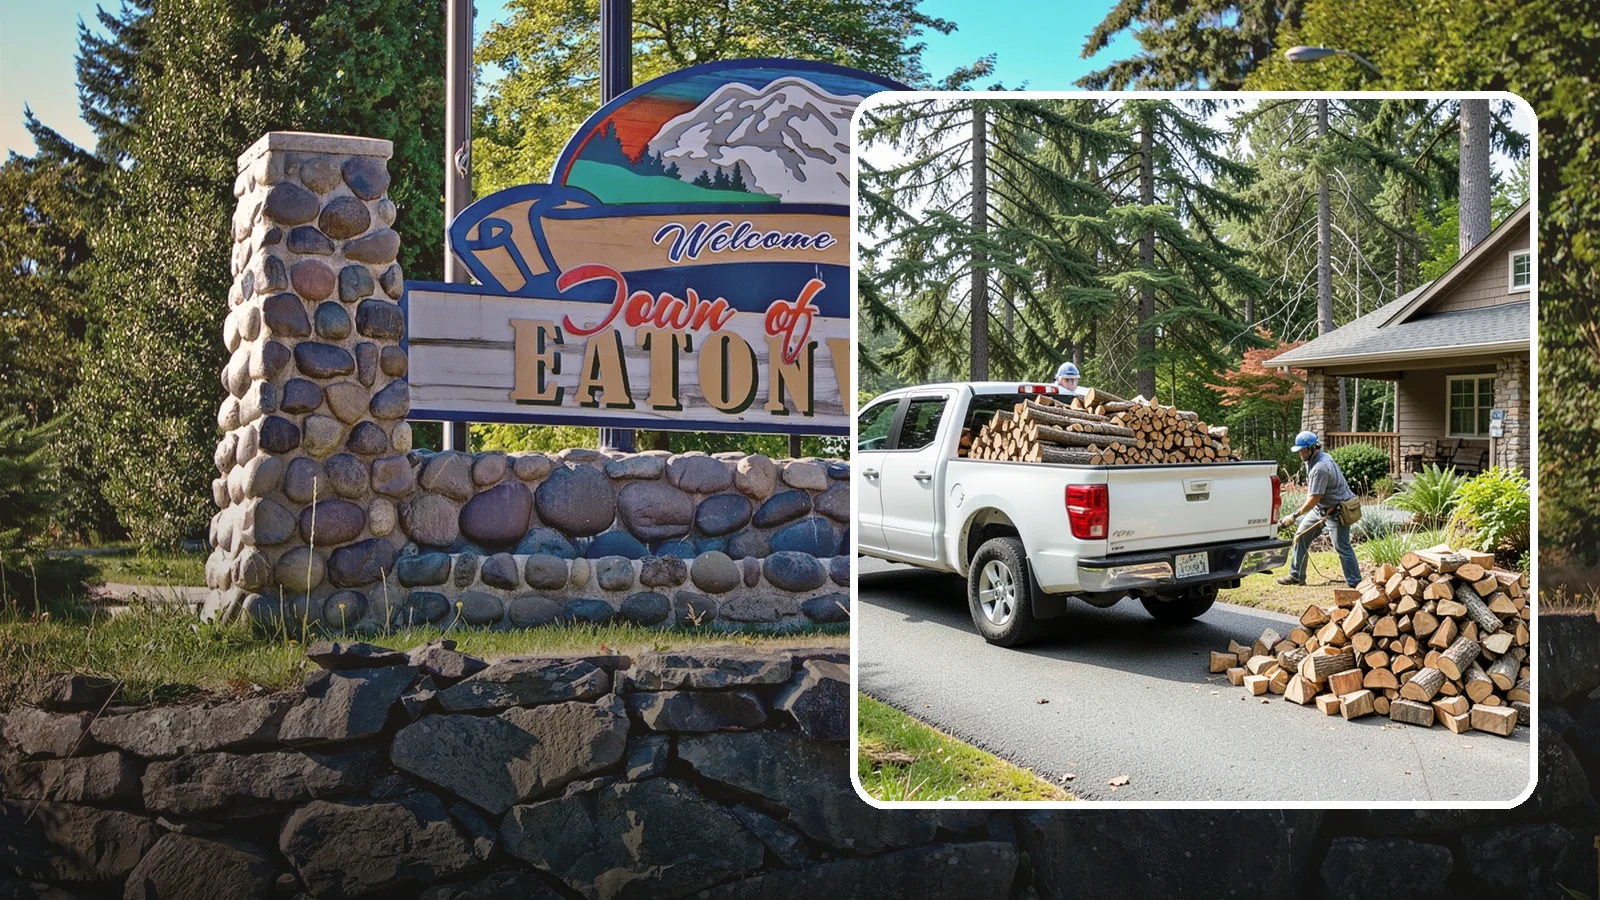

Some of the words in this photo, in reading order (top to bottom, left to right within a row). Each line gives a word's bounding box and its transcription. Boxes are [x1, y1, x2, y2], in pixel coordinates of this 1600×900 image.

[653, 221, 837, 263] Welcome
[556, 263, 738, 337] Town
[765, 278, 826, 365] of
